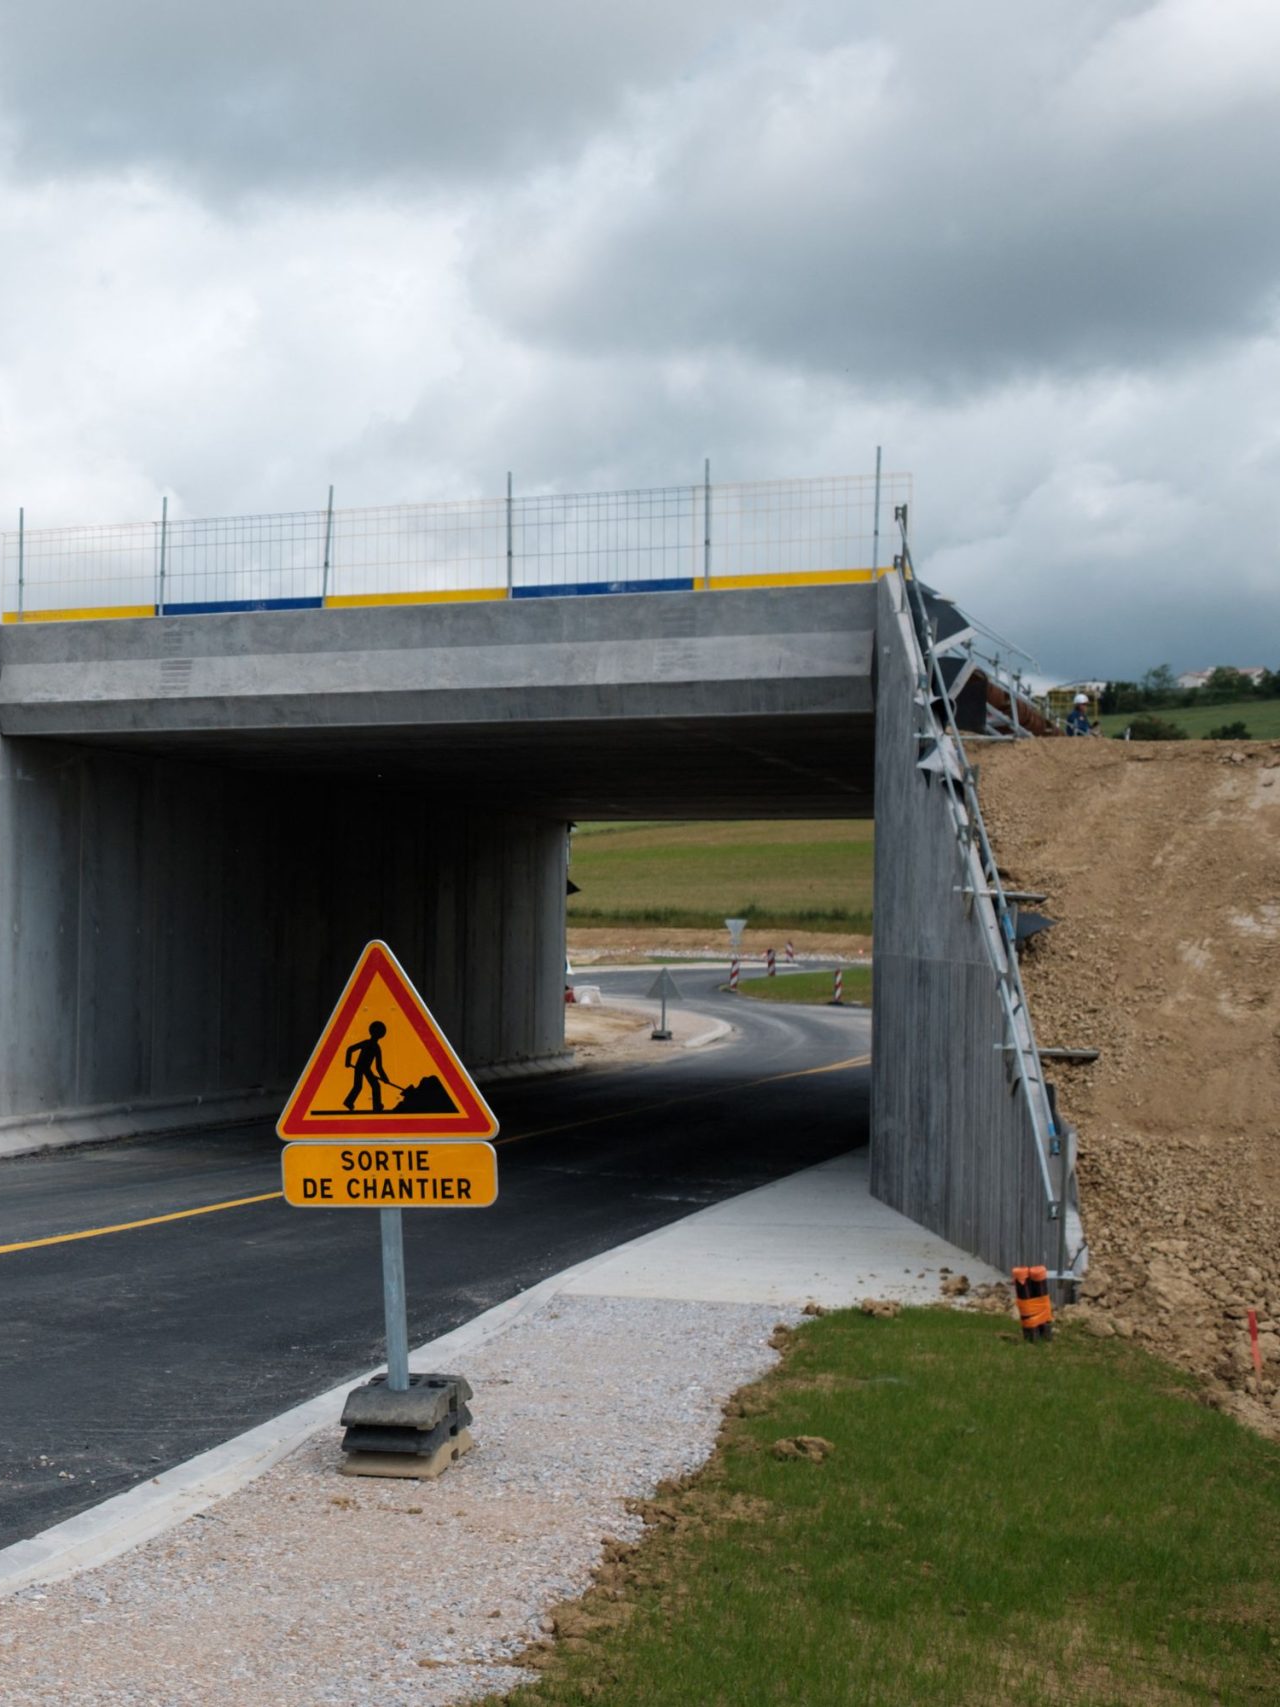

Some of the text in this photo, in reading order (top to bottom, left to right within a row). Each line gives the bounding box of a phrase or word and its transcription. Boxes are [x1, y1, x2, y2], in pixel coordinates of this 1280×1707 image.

[341, 1150, 430, 1171] SORTIE
[303, 1178, 472, 1199] DE CHANTIER
